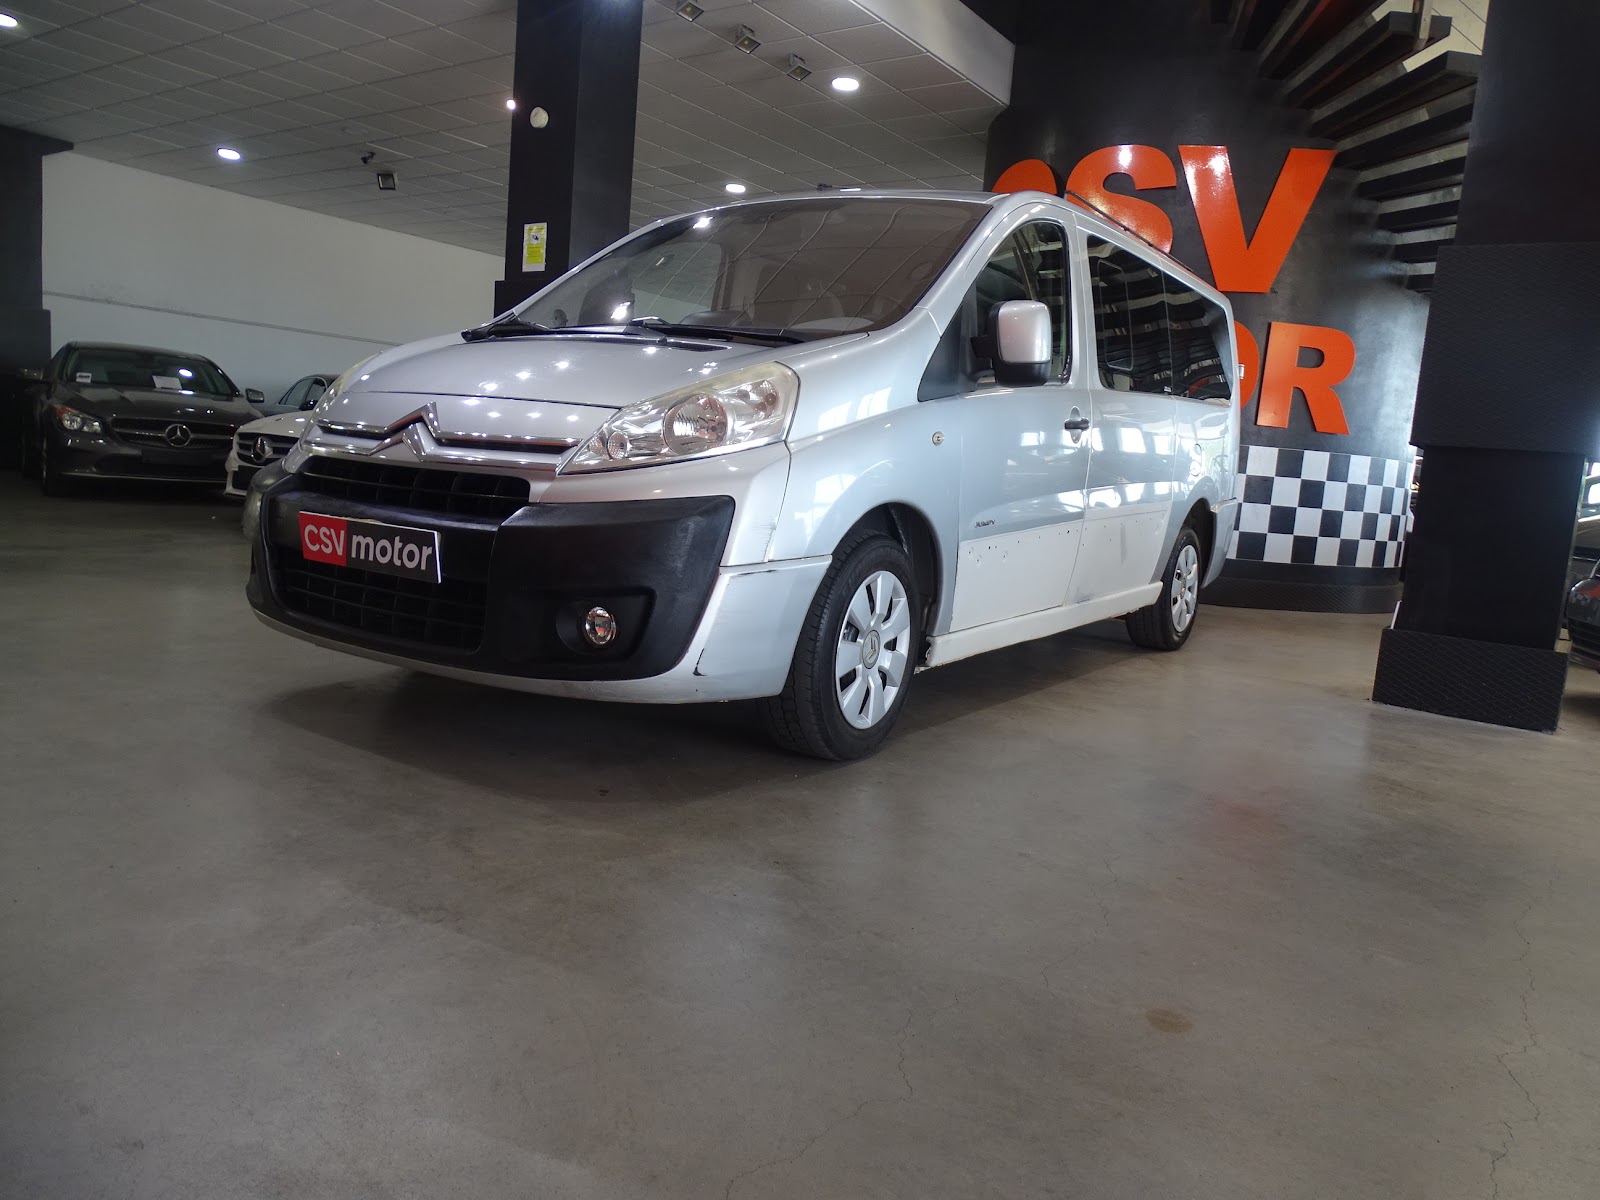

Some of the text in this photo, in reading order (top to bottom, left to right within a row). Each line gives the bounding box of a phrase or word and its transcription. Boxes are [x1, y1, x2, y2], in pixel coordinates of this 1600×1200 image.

[992, 144, 1337, 293] SV
[1235, 321, 1355, 435] R
[304, 524, 433, 570] CSV motor
